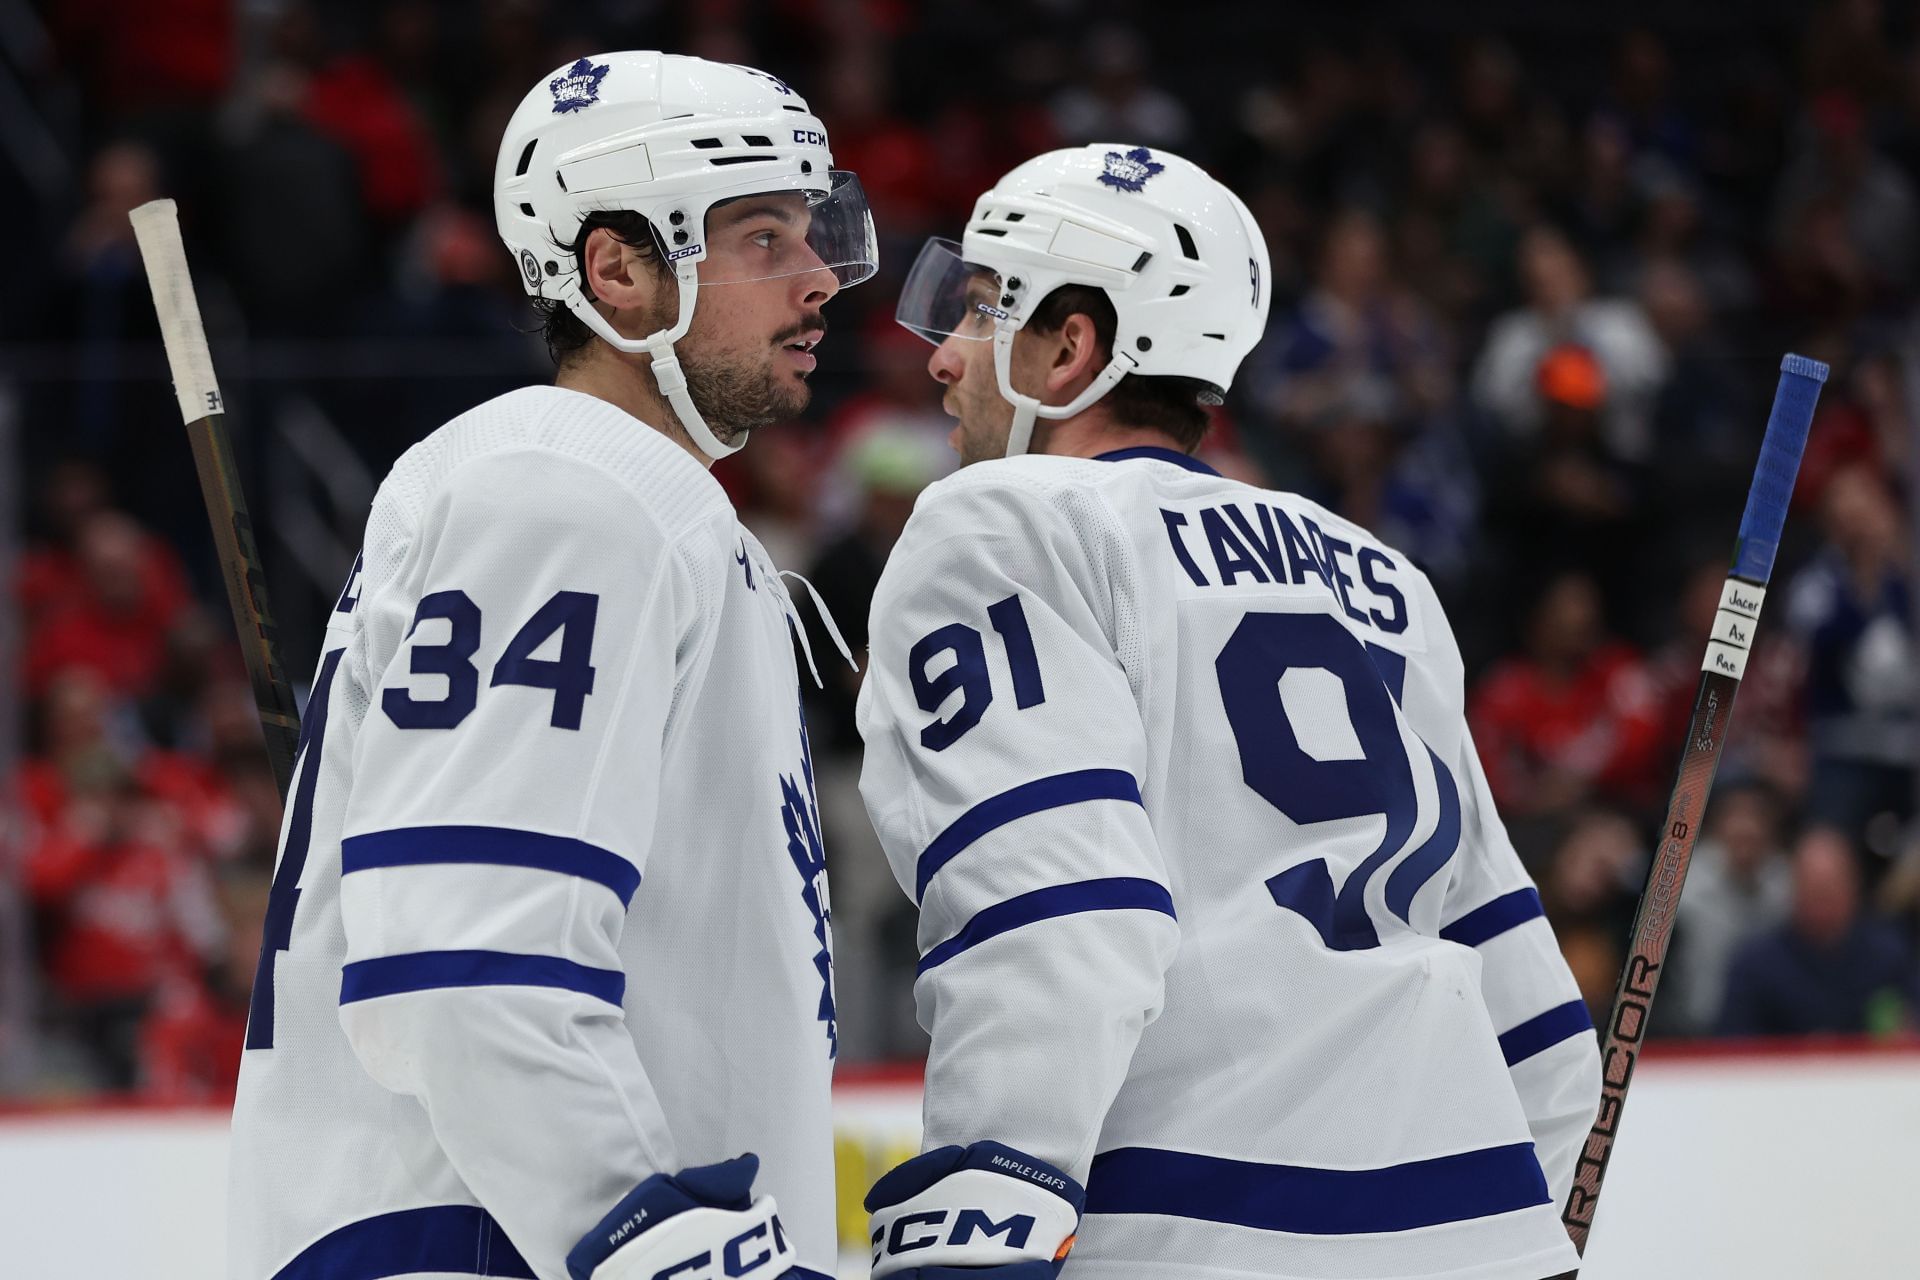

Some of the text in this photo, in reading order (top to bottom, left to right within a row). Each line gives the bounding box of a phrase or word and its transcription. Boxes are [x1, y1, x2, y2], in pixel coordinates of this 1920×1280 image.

[792, 129, 826, 147] CCM
[668, 245, 701, 260] CCM
[1249, 257, 1260, 310] 91
[977, 303, 1008, 320] CCM
[1159, 502, 1409, 635] TAVARES
[1728, 623, 1745, 642] Ax
[381, 589, 600, 731] 34
[908, 594, 1045, 752] 91
[1716, 653, 1736, 672] Rae
[1214, 611, 1461, 952] 91
[1562, 955, 1659, 1228] RIBCOR
[1643, 839, 1683, 943] TRIGGER
[1672, 822, 1688, 840] 8
[991, 1155, 1066, 1190] MAPLE LEAFS
[609, 1208, 648, 1245] PAPI 34
